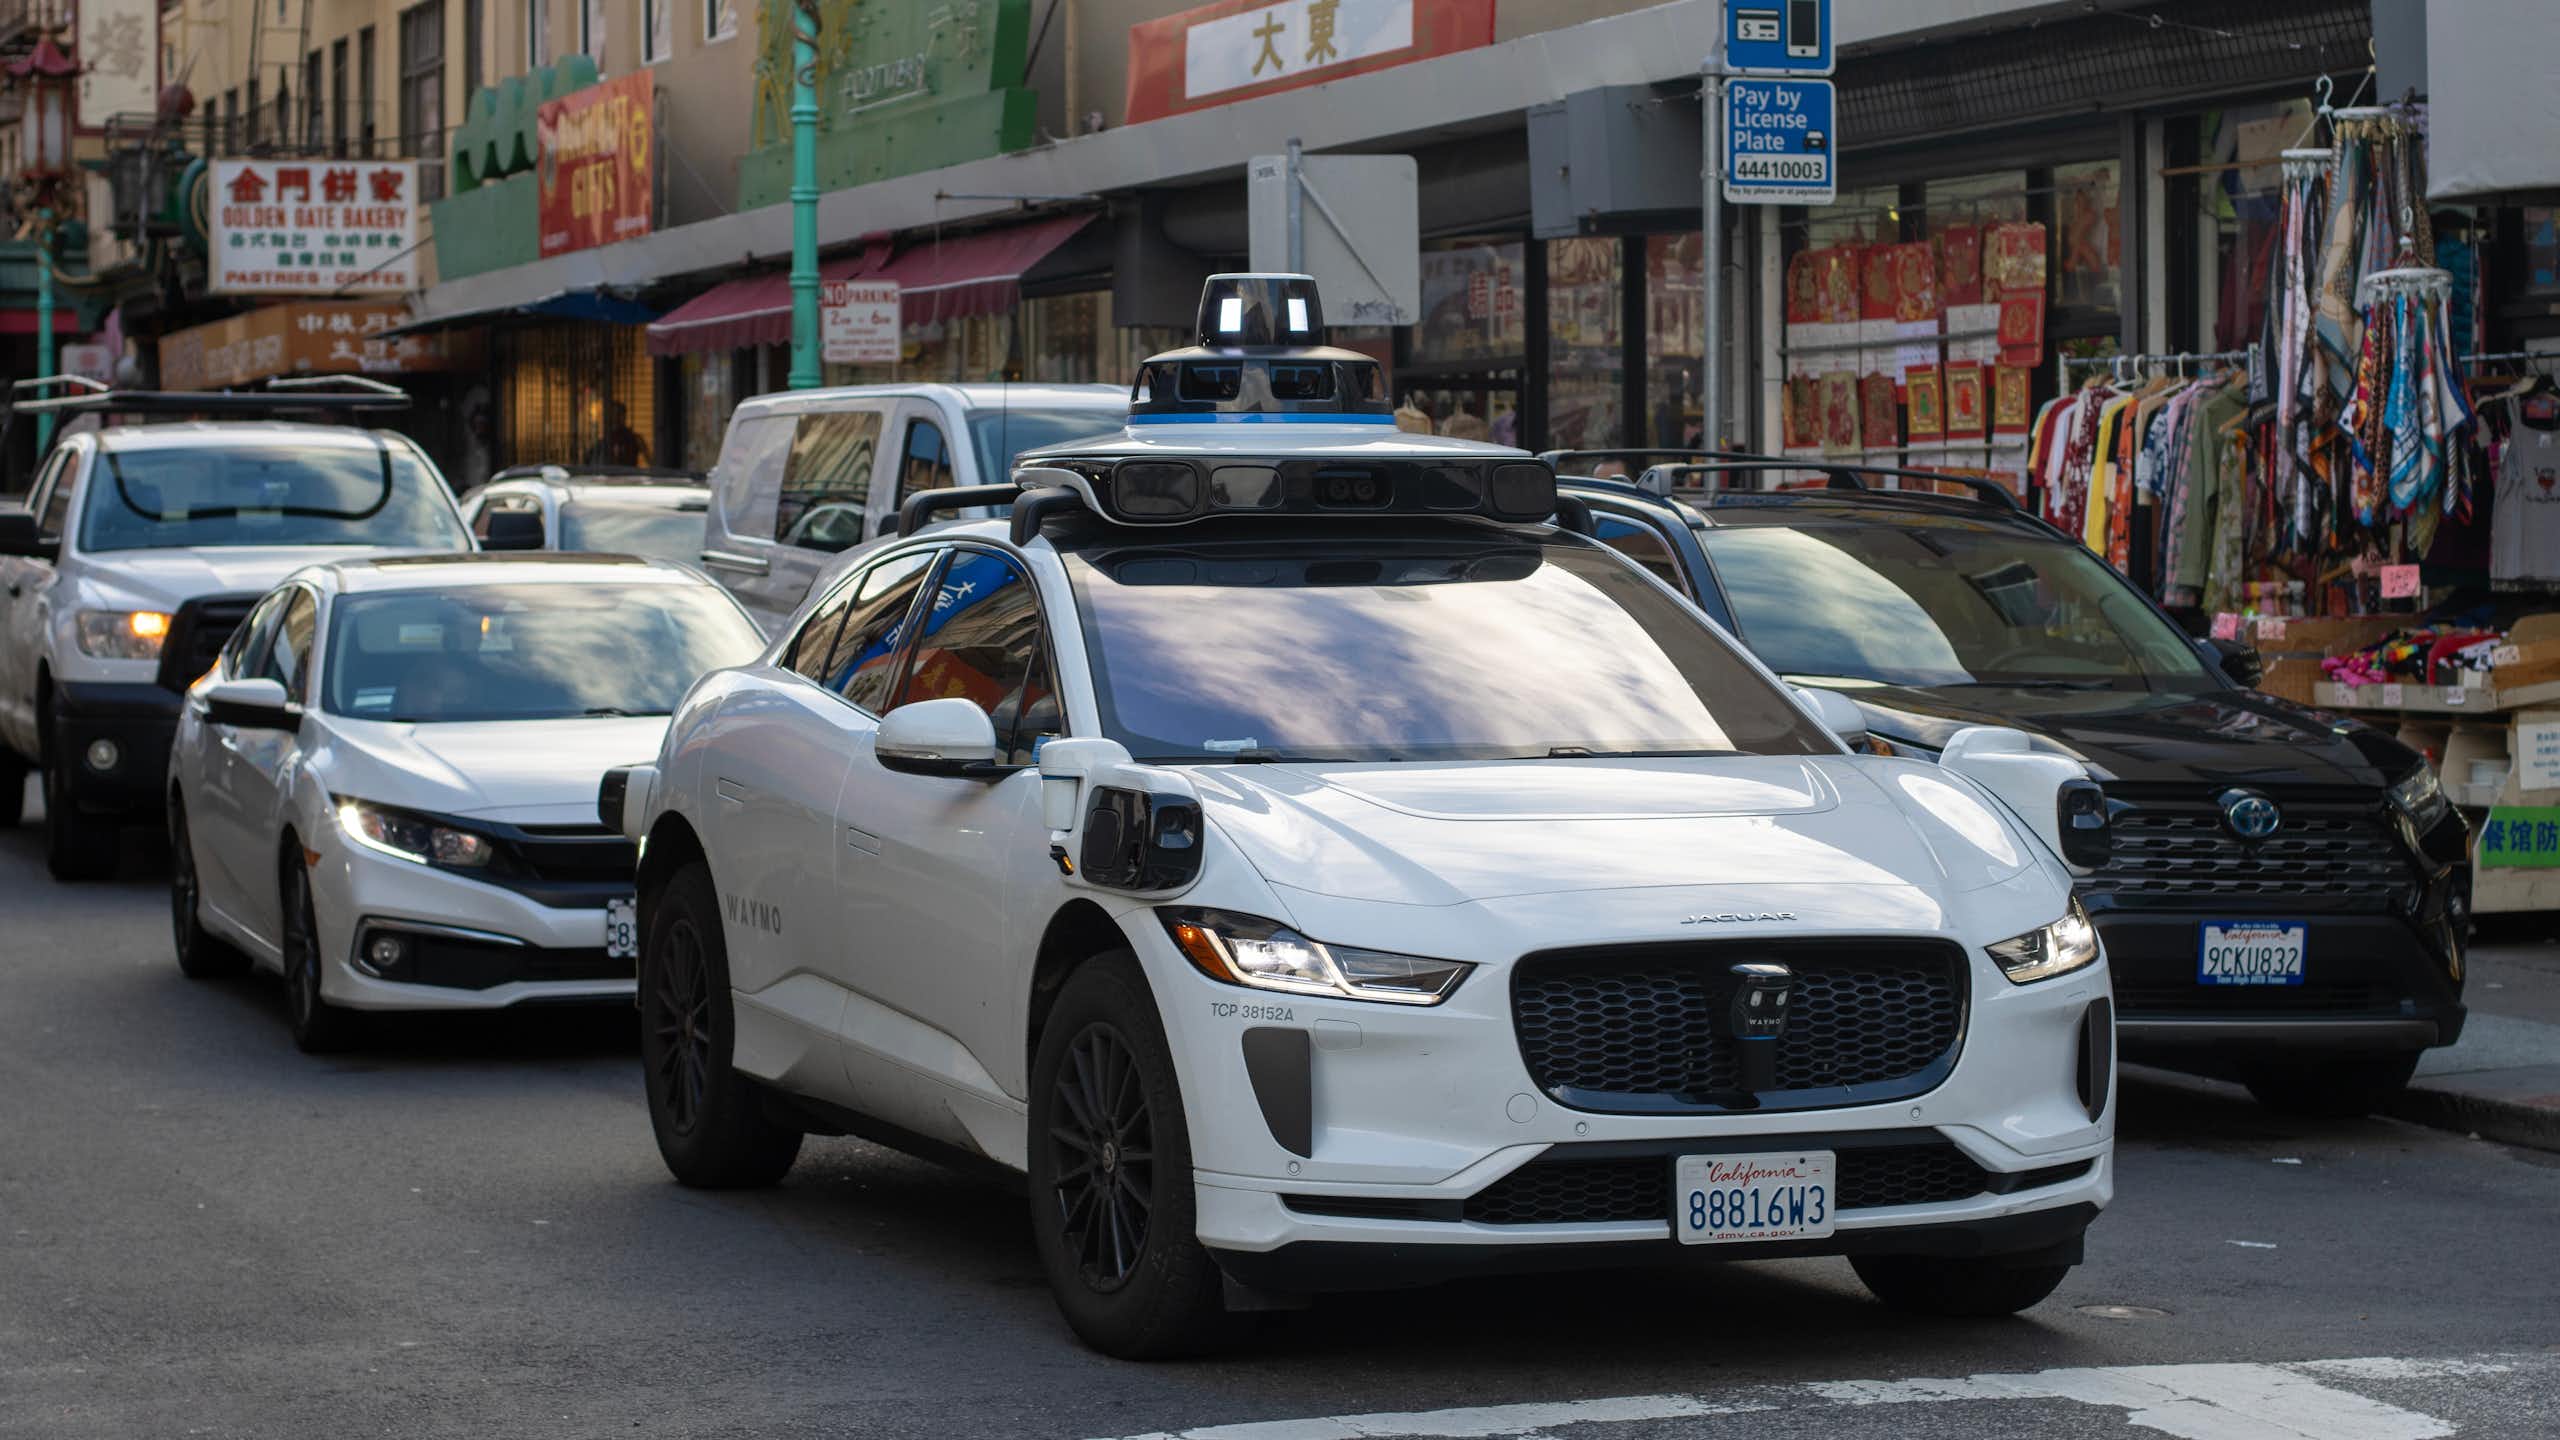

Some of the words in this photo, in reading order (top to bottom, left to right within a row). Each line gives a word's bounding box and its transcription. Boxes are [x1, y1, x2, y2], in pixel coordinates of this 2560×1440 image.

[1252, 0, 1340, 76] 大東
[1734, 85, 1770, 111] Pay
[1776, 85, 1801, 112] by
[1734, 108, 1808, 128] License
[1734, 130, 1785, 151] Plate
[1737, 161, 1823, 180] 44410003
[226, 166, 404, 203] 金門餅家
[223, 206, 286, 228] GOLDEN
[295, 206, 335, 228] GATE
[343, 206, 407, 228] BAKERY
[225, 271, 320, 284] PASTRIES
[335, 271, 406, 284] COFFEE
[847, 288, 899, 305] PARKING
[726, 893, 782, 934] WAYMO
[1679, 912, 1798, 924] JAGUAR
[2223, 928, 2286, 945] California
[2208, 946, 2299, 976] 9CKU832
[1211, 1002, 1238, 1017] TCP
[1241, 1005, 1295, 1021] 38152A
[1749, 1016, 1782, 1025] WAYMO
[1709, 1161, 1806, 1187] California
[1689, 1184, 1825, 1230] 88816W3
[1716, 1230, 1796, 1240] dmv.ca.gov
